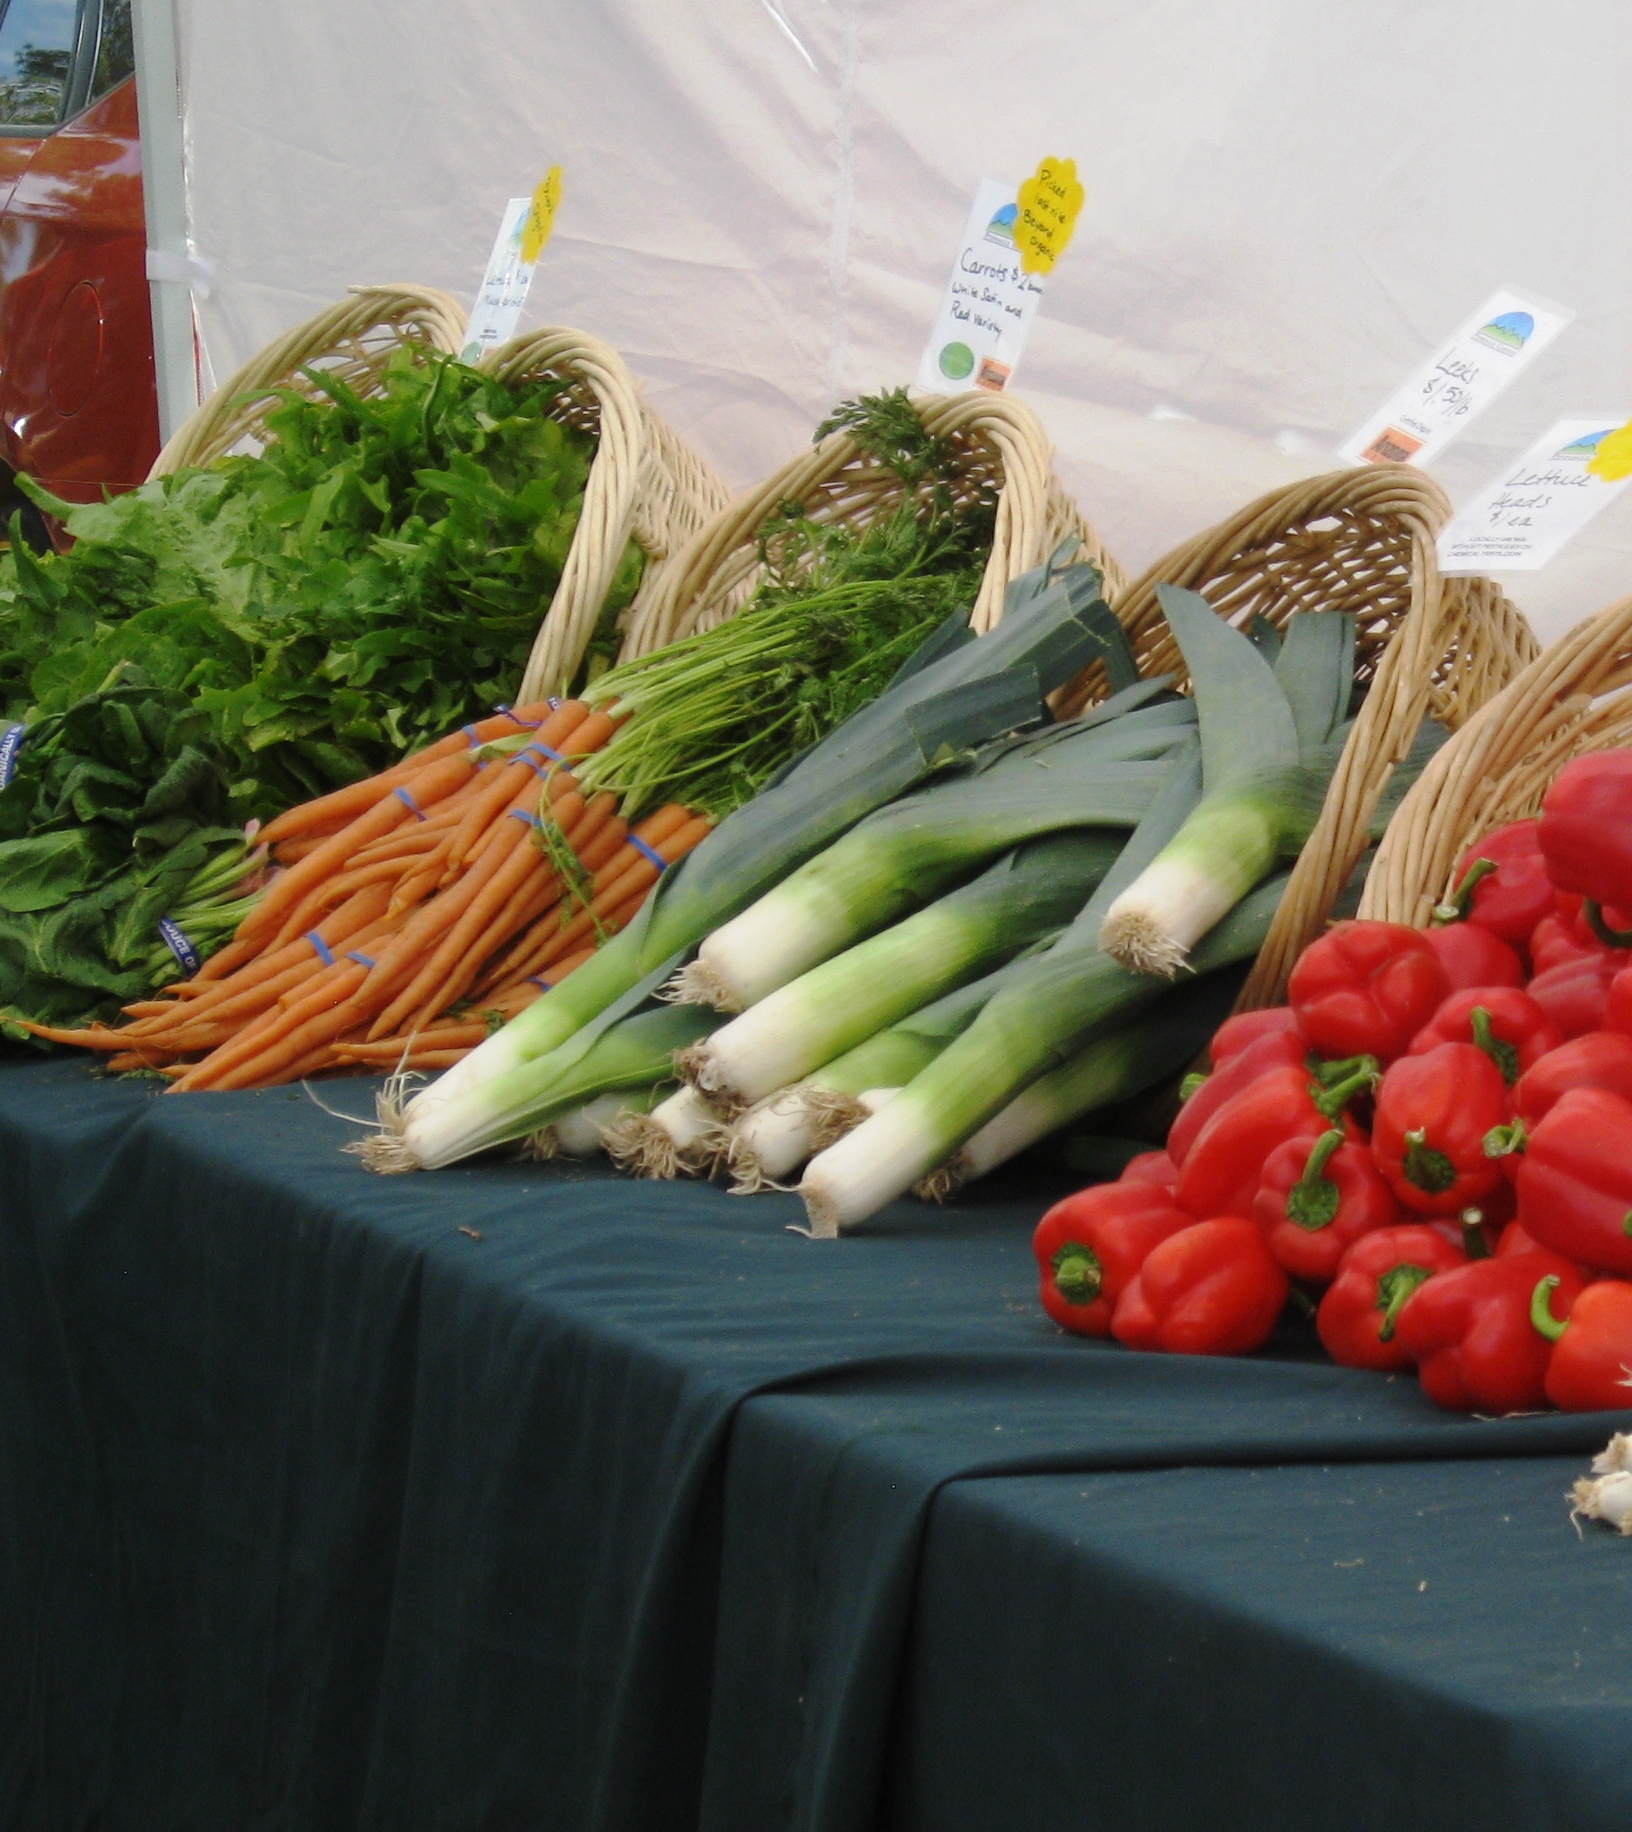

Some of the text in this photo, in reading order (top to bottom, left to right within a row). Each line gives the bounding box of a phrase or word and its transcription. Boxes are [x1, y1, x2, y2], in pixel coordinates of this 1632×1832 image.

[961, 247, 1008, 282] Carrots
[951, 300, 971, 321] Red
[1434, 347, 1480, 385] Leeks
[1505, 468, 1592, 488] Lettuce
[1488, 491, 1552, 510] Heads
